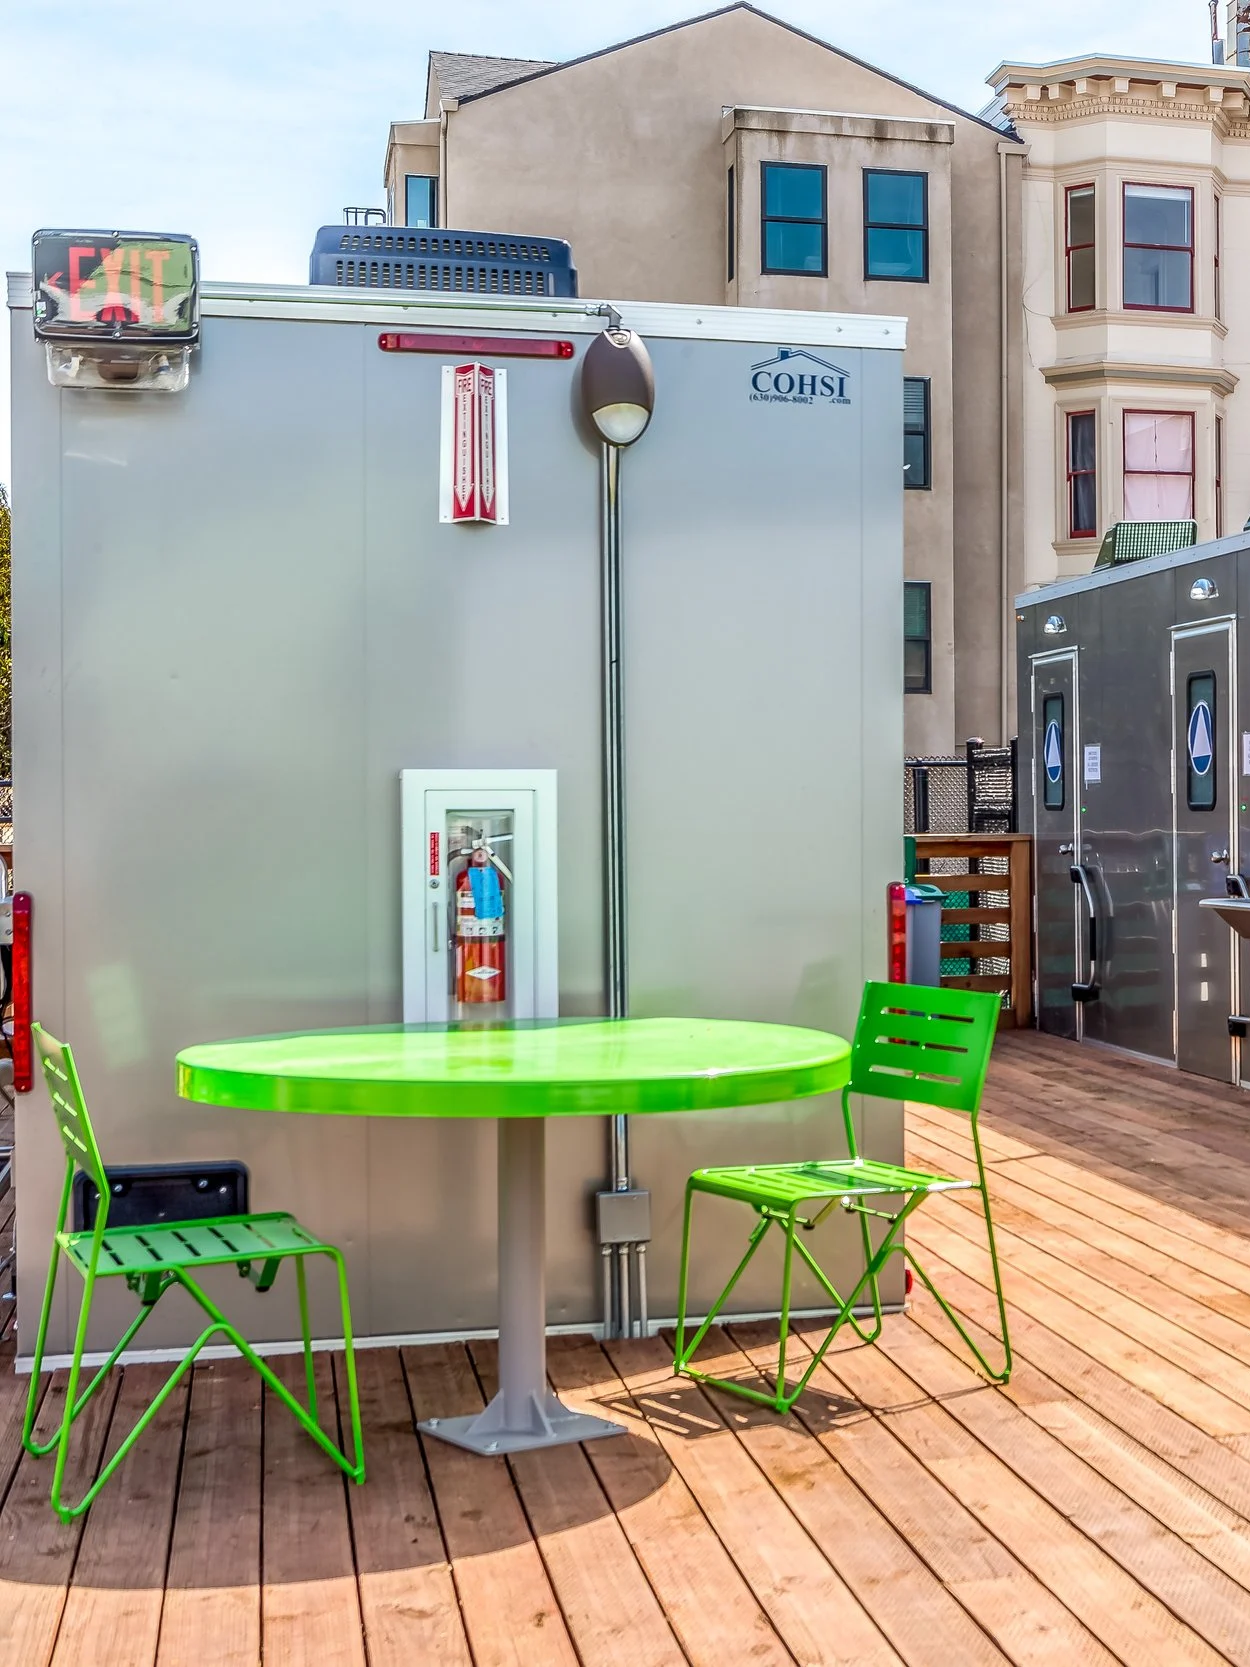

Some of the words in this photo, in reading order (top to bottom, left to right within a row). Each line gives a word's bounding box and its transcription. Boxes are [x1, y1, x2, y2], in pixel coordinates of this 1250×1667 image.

[68, 247, 170, 323] EXIT
[458, 377, 472, 393] FIRE
[480, 378, 493, 396] FIRE
[751, 371, 846, 398] COHSI
